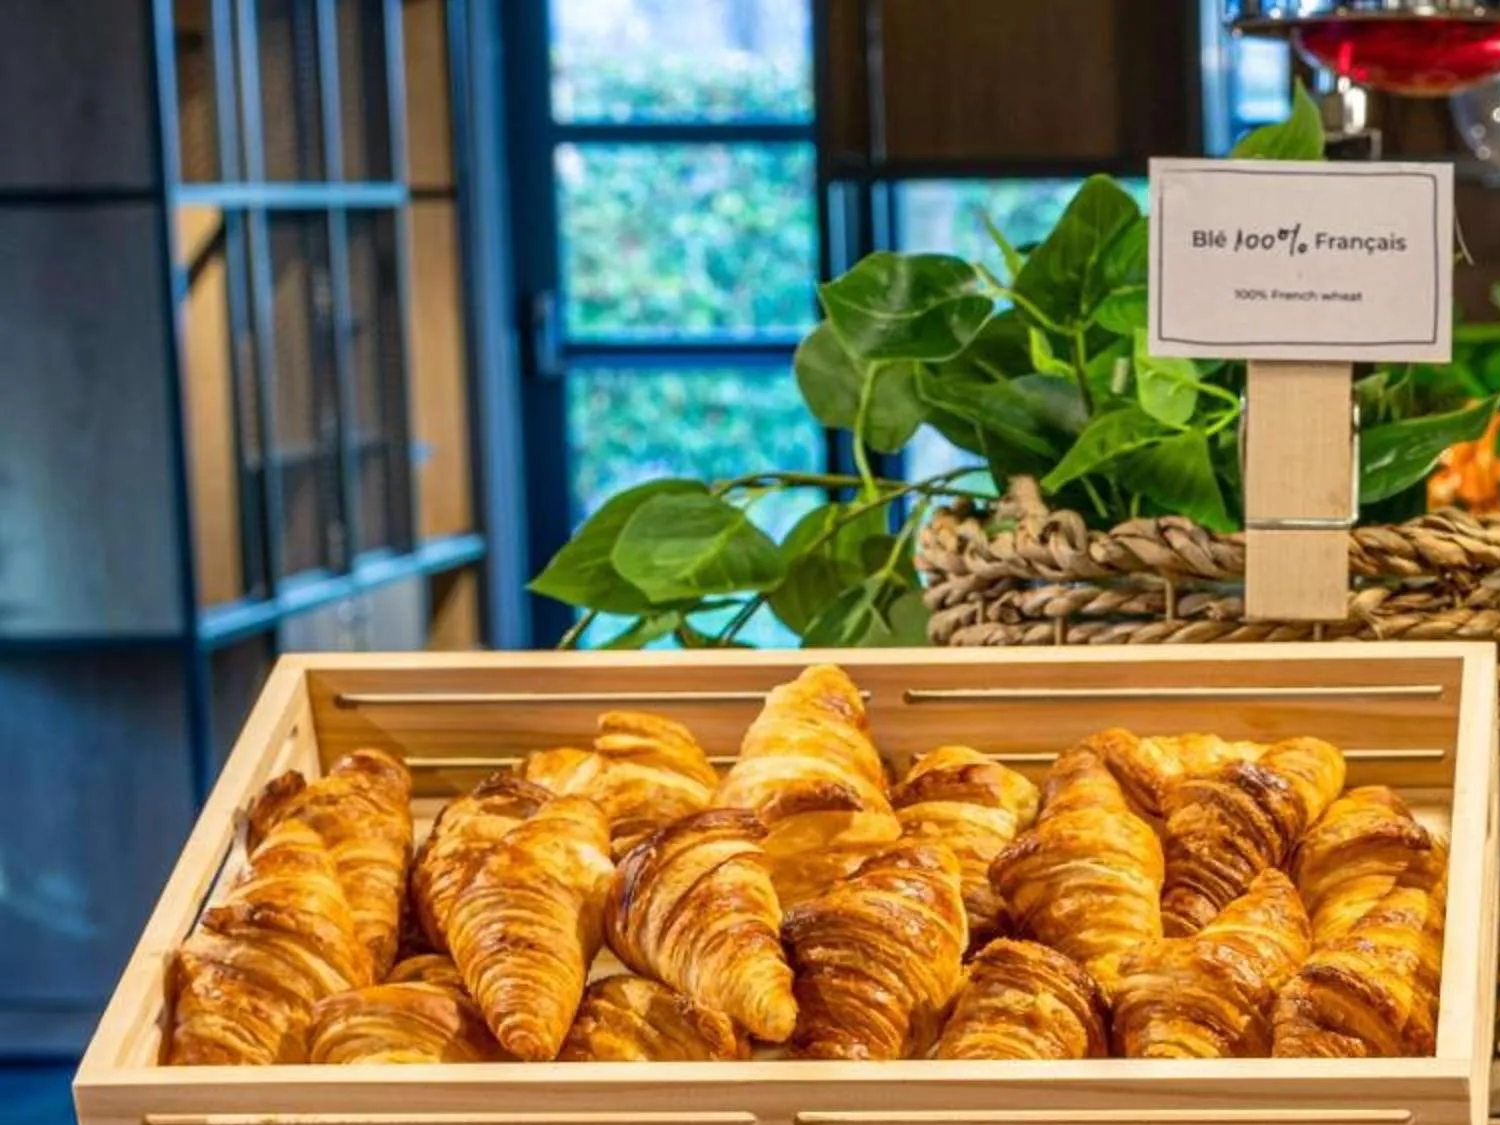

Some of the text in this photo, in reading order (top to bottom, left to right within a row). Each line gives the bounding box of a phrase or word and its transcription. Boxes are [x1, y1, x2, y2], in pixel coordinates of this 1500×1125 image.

[1191, 223, 1408, 256] Blé 100% Français
[1234, 288, 1363, 301] 100% French wheat
